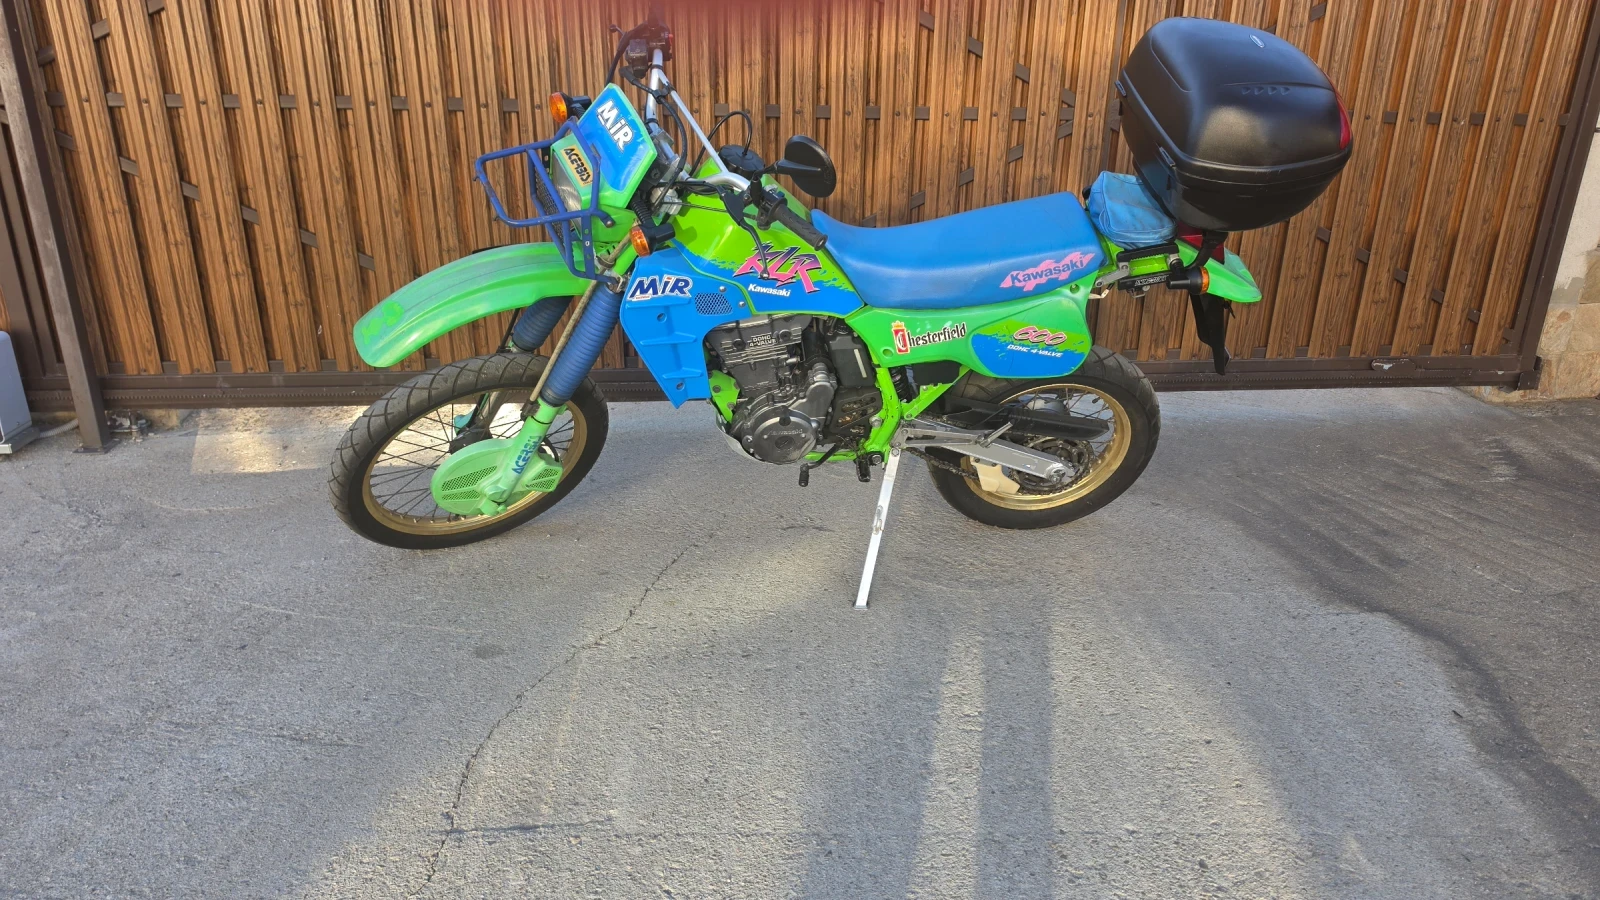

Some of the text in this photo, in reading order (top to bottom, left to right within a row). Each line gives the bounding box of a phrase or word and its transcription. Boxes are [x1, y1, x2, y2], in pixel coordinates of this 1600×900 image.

[597, 100, 634, 151] MiR
[564, 148, 591, 182] ACERBIS
[733, 242, 822, 294] KLR
[1010, 257, 1085, 286] Kawasaki
[628, 275, 691, 298] MiR
[747, 283, 791, 297] Kawasaki
[894, 322, 967, 351] Chesterfield
[1013, 326, 1067, 346] 600
[1007, 344, 1064, 358] DOHC 4-VALVE
